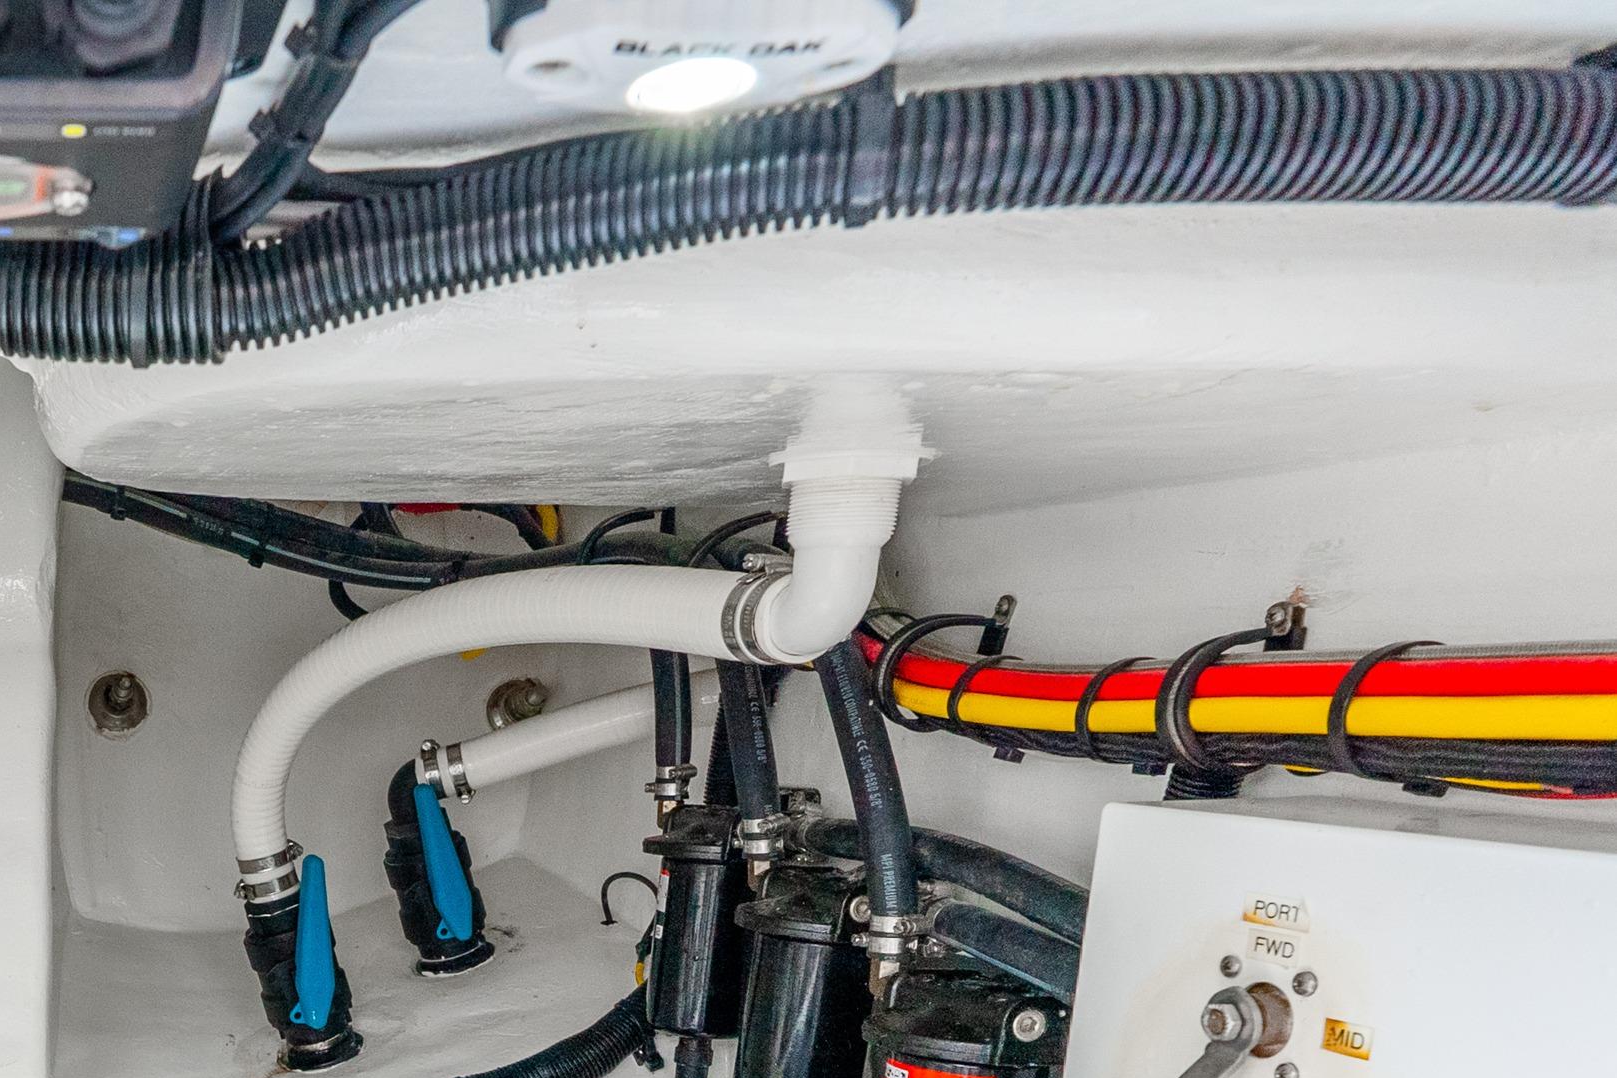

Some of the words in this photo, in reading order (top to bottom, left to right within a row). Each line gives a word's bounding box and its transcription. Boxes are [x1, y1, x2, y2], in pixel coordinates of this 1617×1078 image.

[614, 39, 733, 56] BLACK
[748, 36, 827, 55] OAK
[883, 870, 898, 909] PREMIUM
[1252, 899, 1300, 923] PORT
[1253, 936, 1296, 959] FWD
[1325, 1025, 1366, 1051] MID
